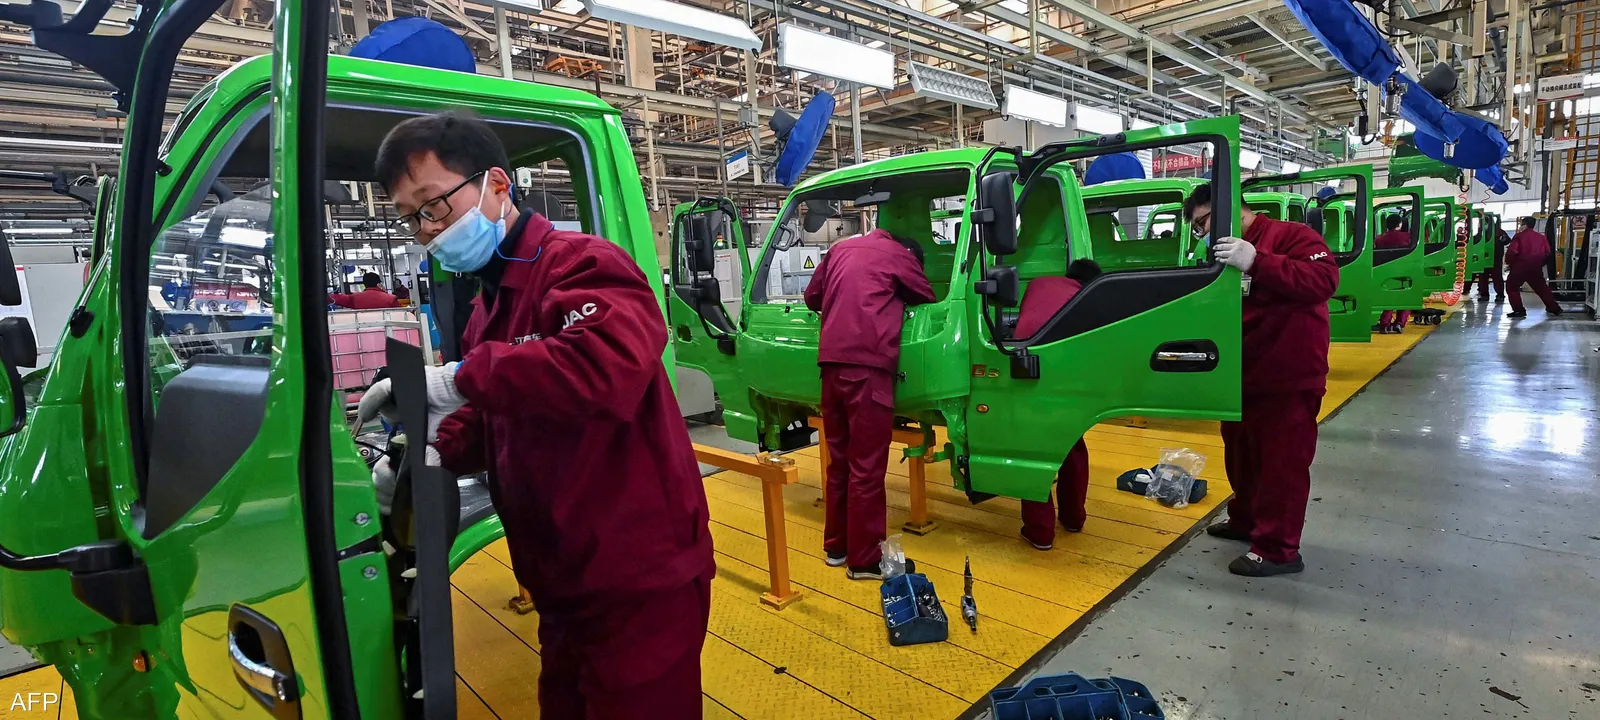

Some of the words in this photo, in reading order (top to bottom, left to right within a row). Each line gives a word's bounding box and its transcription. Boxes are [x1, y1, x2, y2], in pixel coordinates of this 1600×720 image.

[1152, 156, 1189, 170] 不不合格品
[562, 303, 597, 329] JAC
